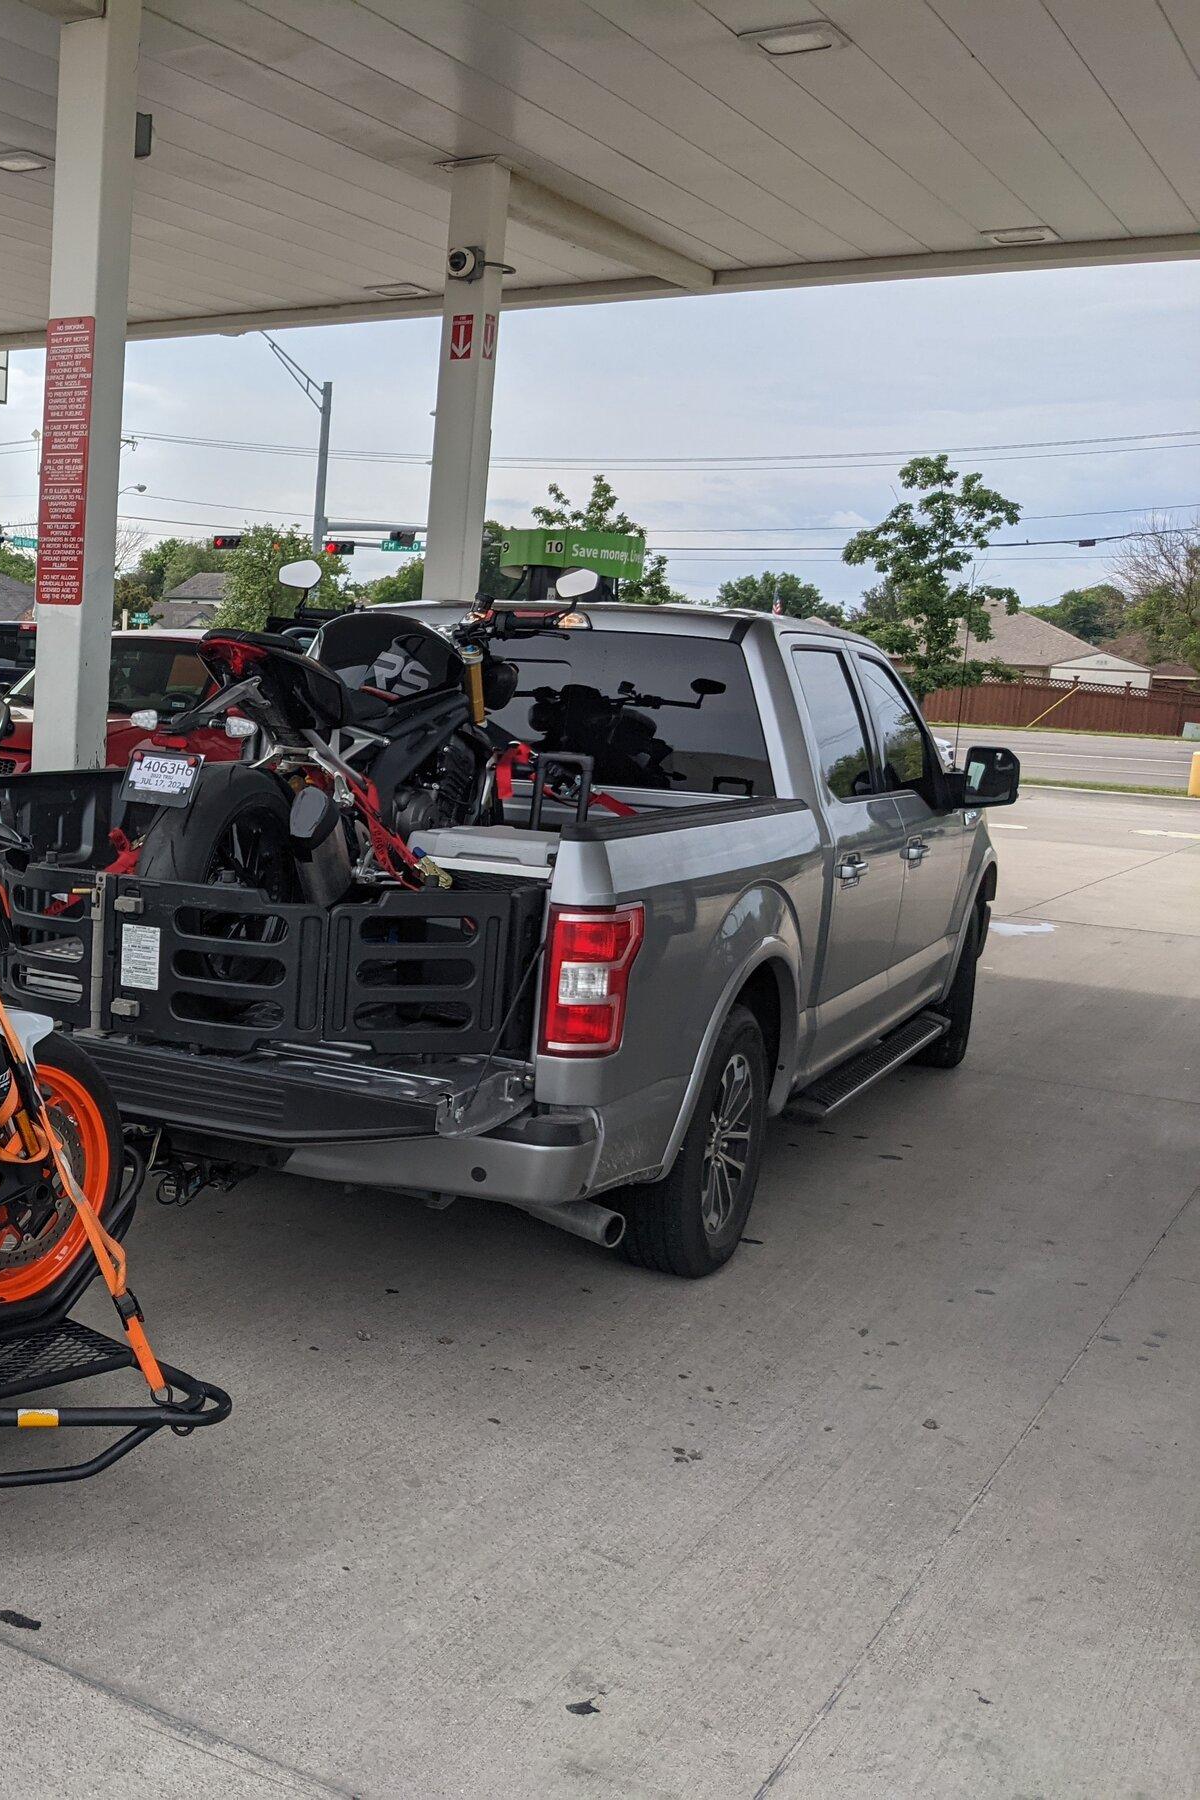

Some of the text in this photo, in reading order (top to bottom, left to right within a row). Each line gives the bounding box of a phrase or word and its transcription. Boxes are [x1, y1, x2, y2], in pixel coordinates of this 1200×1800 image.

[384, 542, 395, 550] FM
[502, 542, 510, 553] 9
[547, 541, 563, 553] 10
[571, 543, 630, 565] Save money.
[373, 651, 432, 696] RS
[139, 777, 152, 786] JUL
